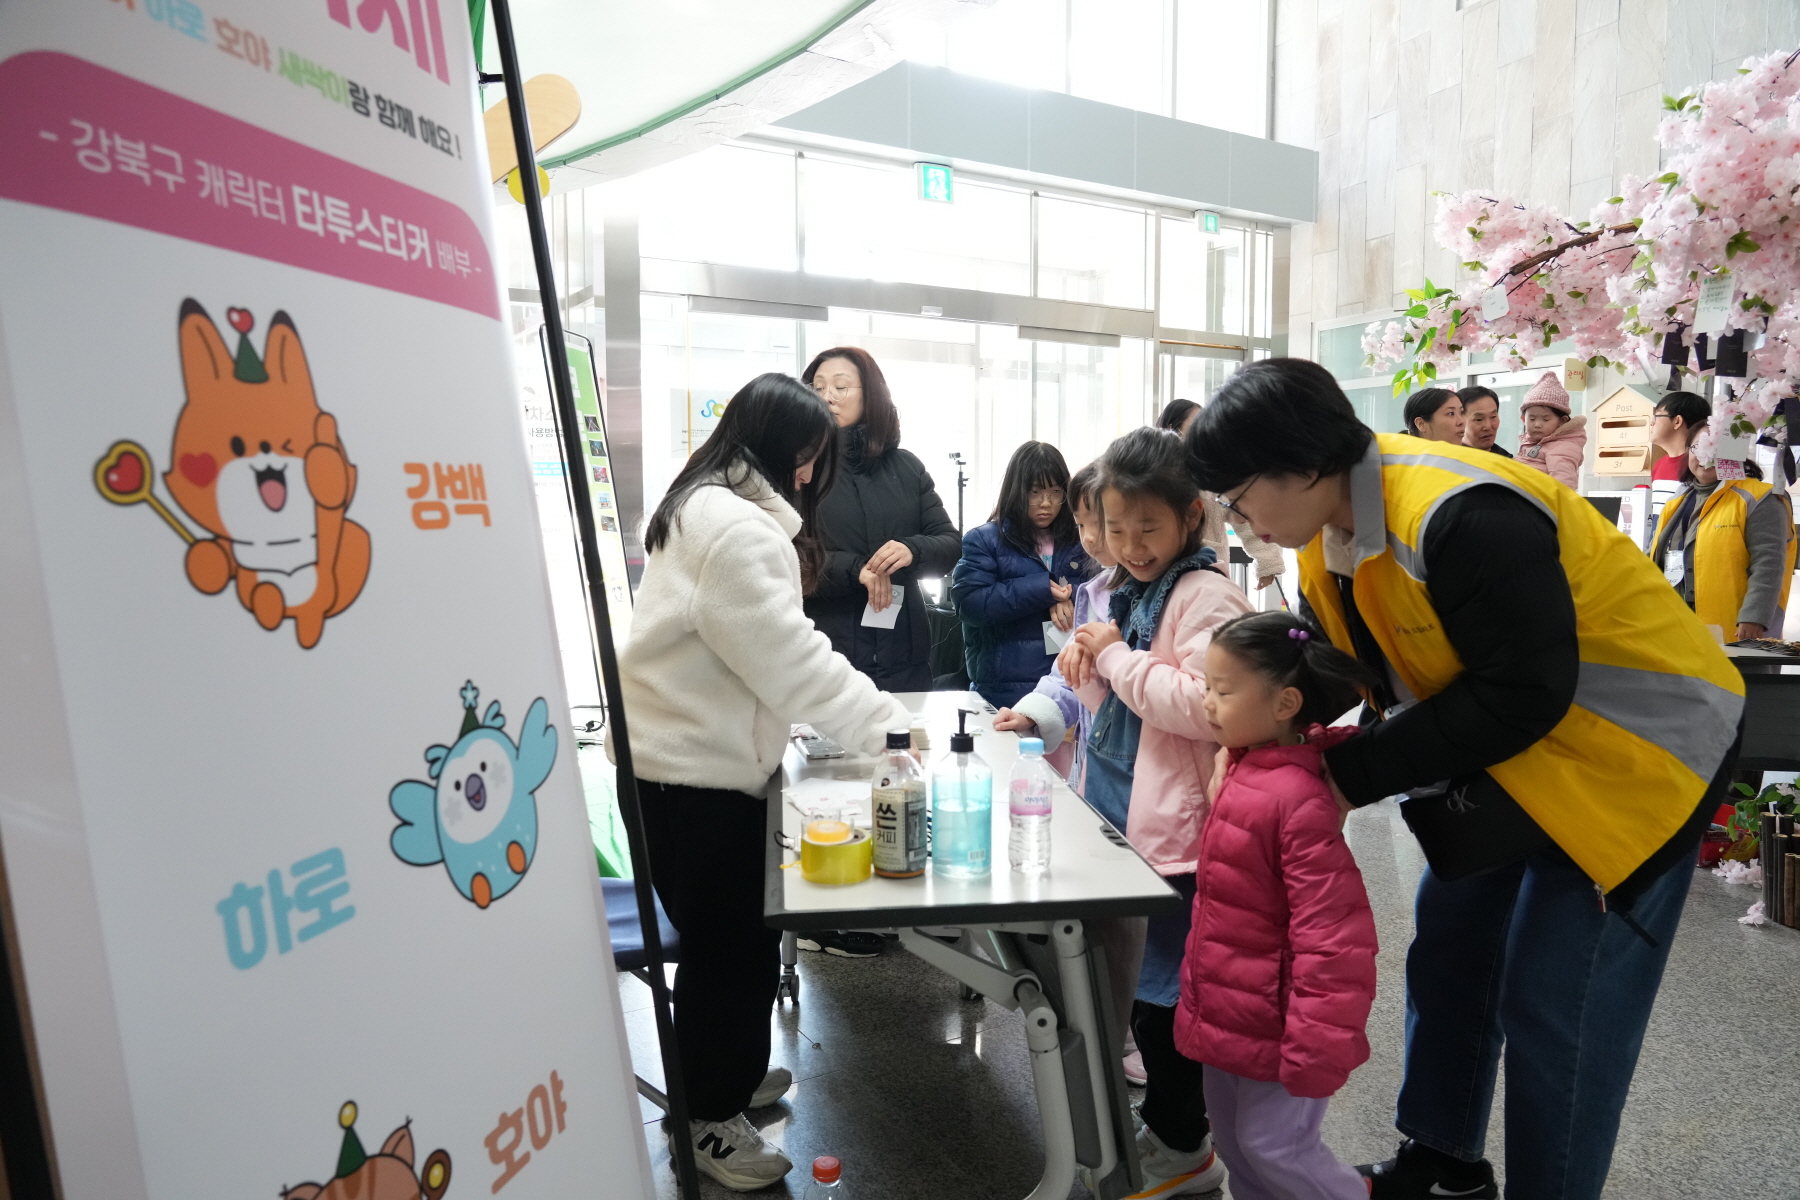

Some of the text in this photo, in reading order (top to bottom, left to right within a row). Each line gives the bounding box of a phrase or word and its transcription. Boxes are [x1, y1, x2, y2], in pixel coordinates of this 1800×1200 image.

[213, 17, 270, 72] 호야
[375, 94, 417, 139] 함께
[70, 118, 187, 194] 강북구
[195, 159, 287, 225] 캐릭터
[291, 184, 433, 269] 타투스티커
[1616, 404, 1633, 412] Post
[403, 462, 492, 530] 강백
[876, 802, 898, 831] 쓴
[876, 830, 897, 844] 커피
[216, 847, 356, 970] 하로
[484, 1069, 567, 1195] 호야
